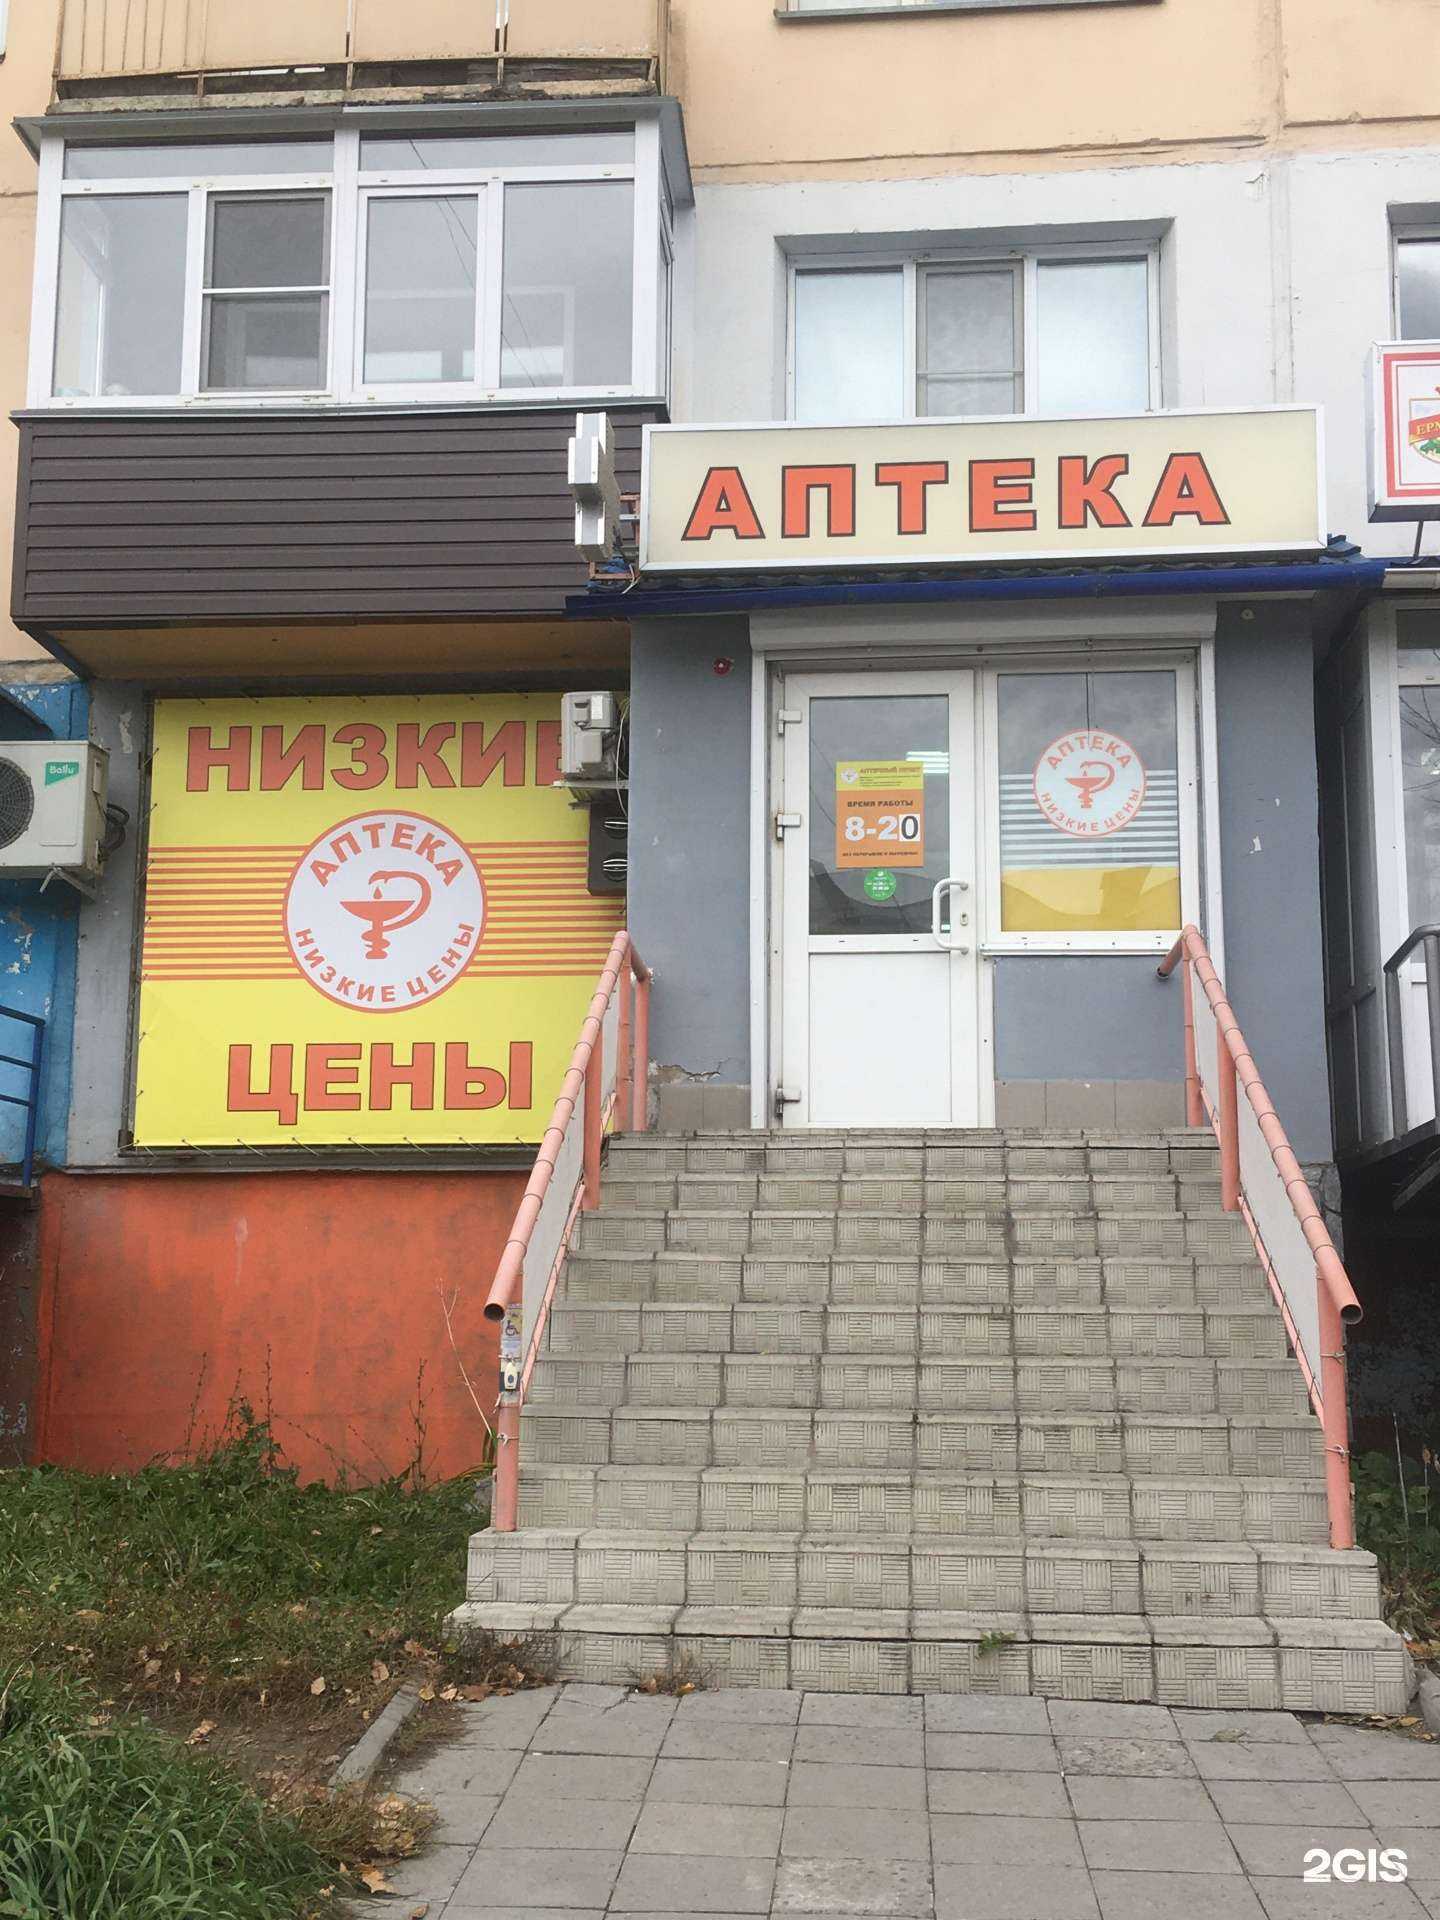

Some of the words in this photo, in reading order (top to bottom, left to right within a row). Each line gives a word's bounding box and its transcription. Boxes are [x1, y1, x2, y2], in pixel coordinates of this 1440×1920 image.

[680, 452, 1232, 541] АПТЕКА
[1046, 735, 1132, 769] АПТЕКА
[844, 814, 919, 842] 8-20
[847, 800, 876, 808] ВРЕМЯ
[877, 799, 914, 807] РАБОТЫ
[1041, 791, 1099, 832] НИЗКИЕ
[1104, 788, 1140, 829] ЦЕНЫ
[309, 822, 464, 888] АПТЕКА
[295, 927, 396, 1003] НИЗКИЕ
[406, 922, 476, 998] ЦЕНЫ
[226, 1040, 534, 1126] ЦЕНЫ
